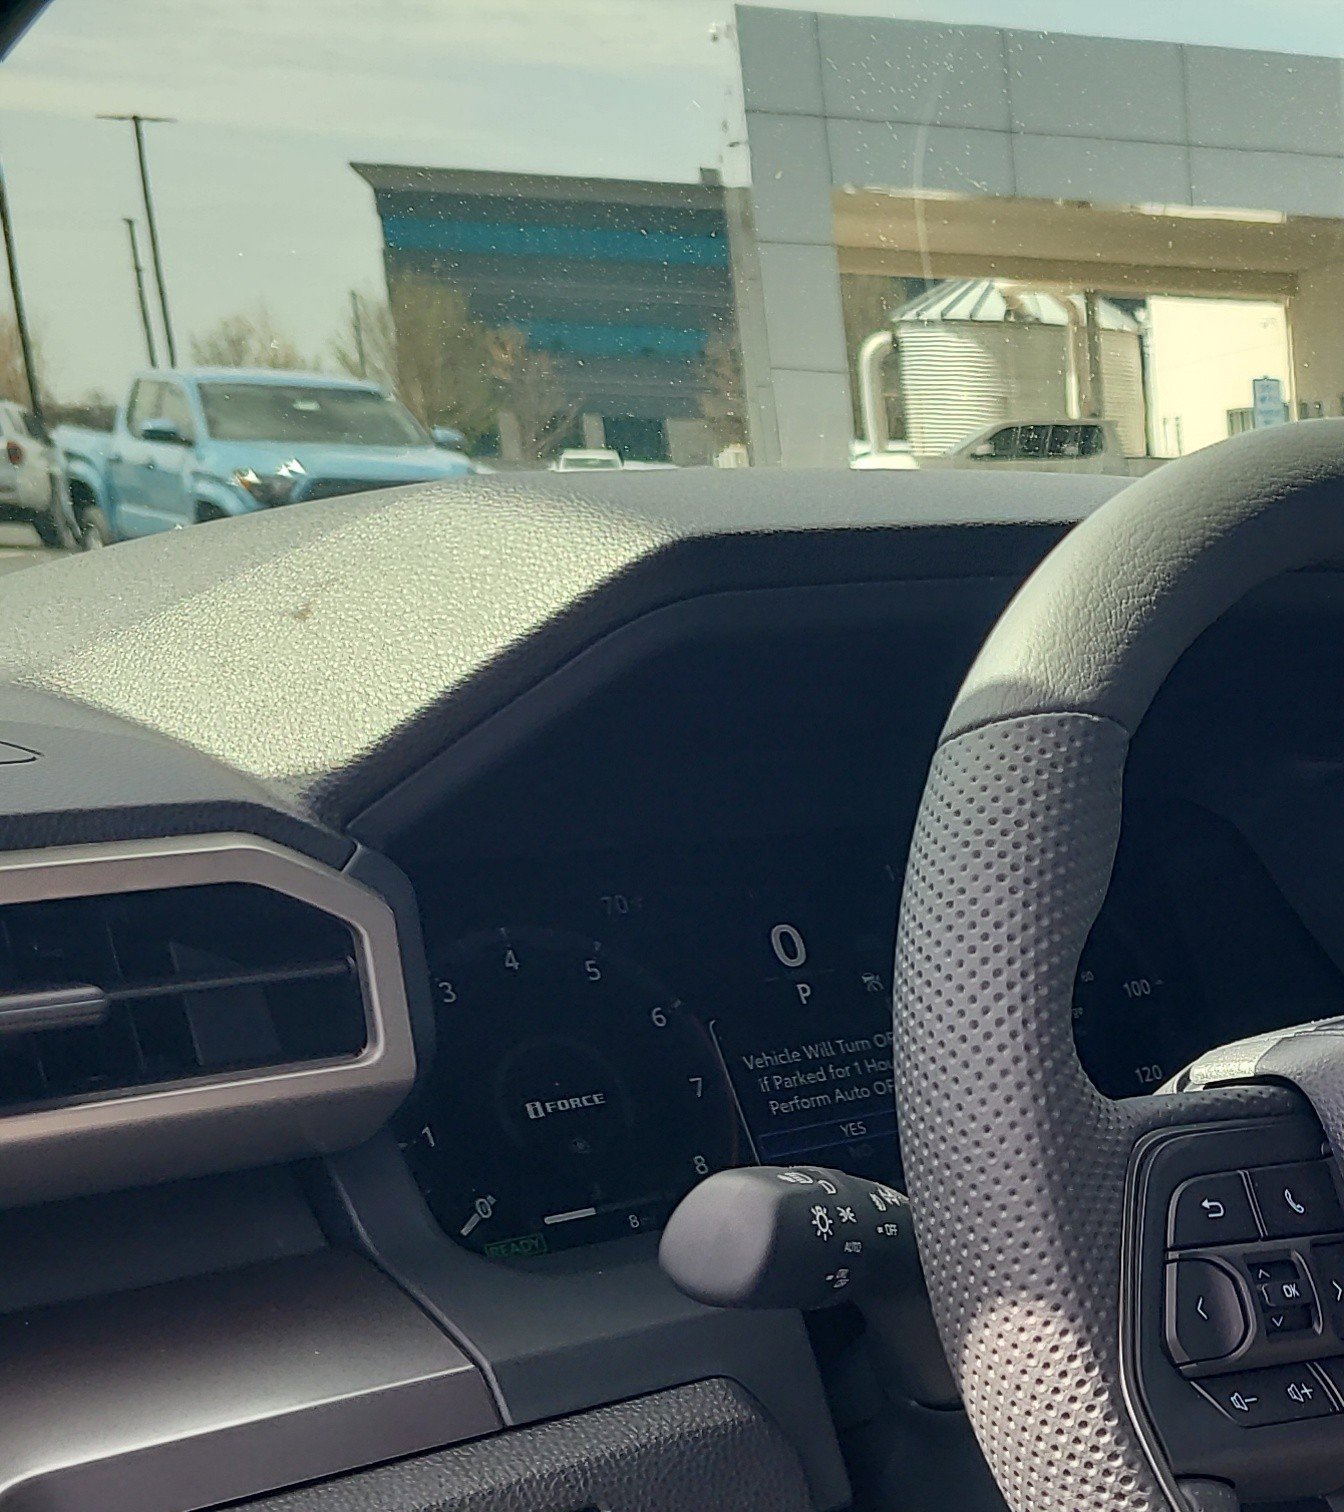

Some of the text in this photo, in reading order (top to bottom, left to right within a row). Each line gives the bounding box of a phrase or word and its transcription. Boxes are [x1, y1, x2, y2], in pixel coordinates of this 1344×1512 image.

[771, 924, 807, 968] 0
[504, 949, 520, 971] 4
[584, 959, 601, 982] 5
[438, 982, 457, 1003] 3
[797, 983, 811, 1004] P
[1123, 979, 1151, 998] 100
[651, 1007, 667, 1027] 6
[742, 1032, 894, 1070] Vehicle Will Turn OF
[774, 1065, 827, 1091] Parked
[829, 1062, 851, 1080] for
[855, 1061, 863, 1076] 1
[866, 1057, 895, 1073] Hou
[1134, 1064, 1163, 1084] 120
[689, 1077, 703, 1097] 7
[769, 1080, 896, 1116] Perform Auto OF
[839, 1121, 868, 1138] YES
[693, 1155, 709, 1175] 8
[1283, 1284, 1300, 1299] OK
